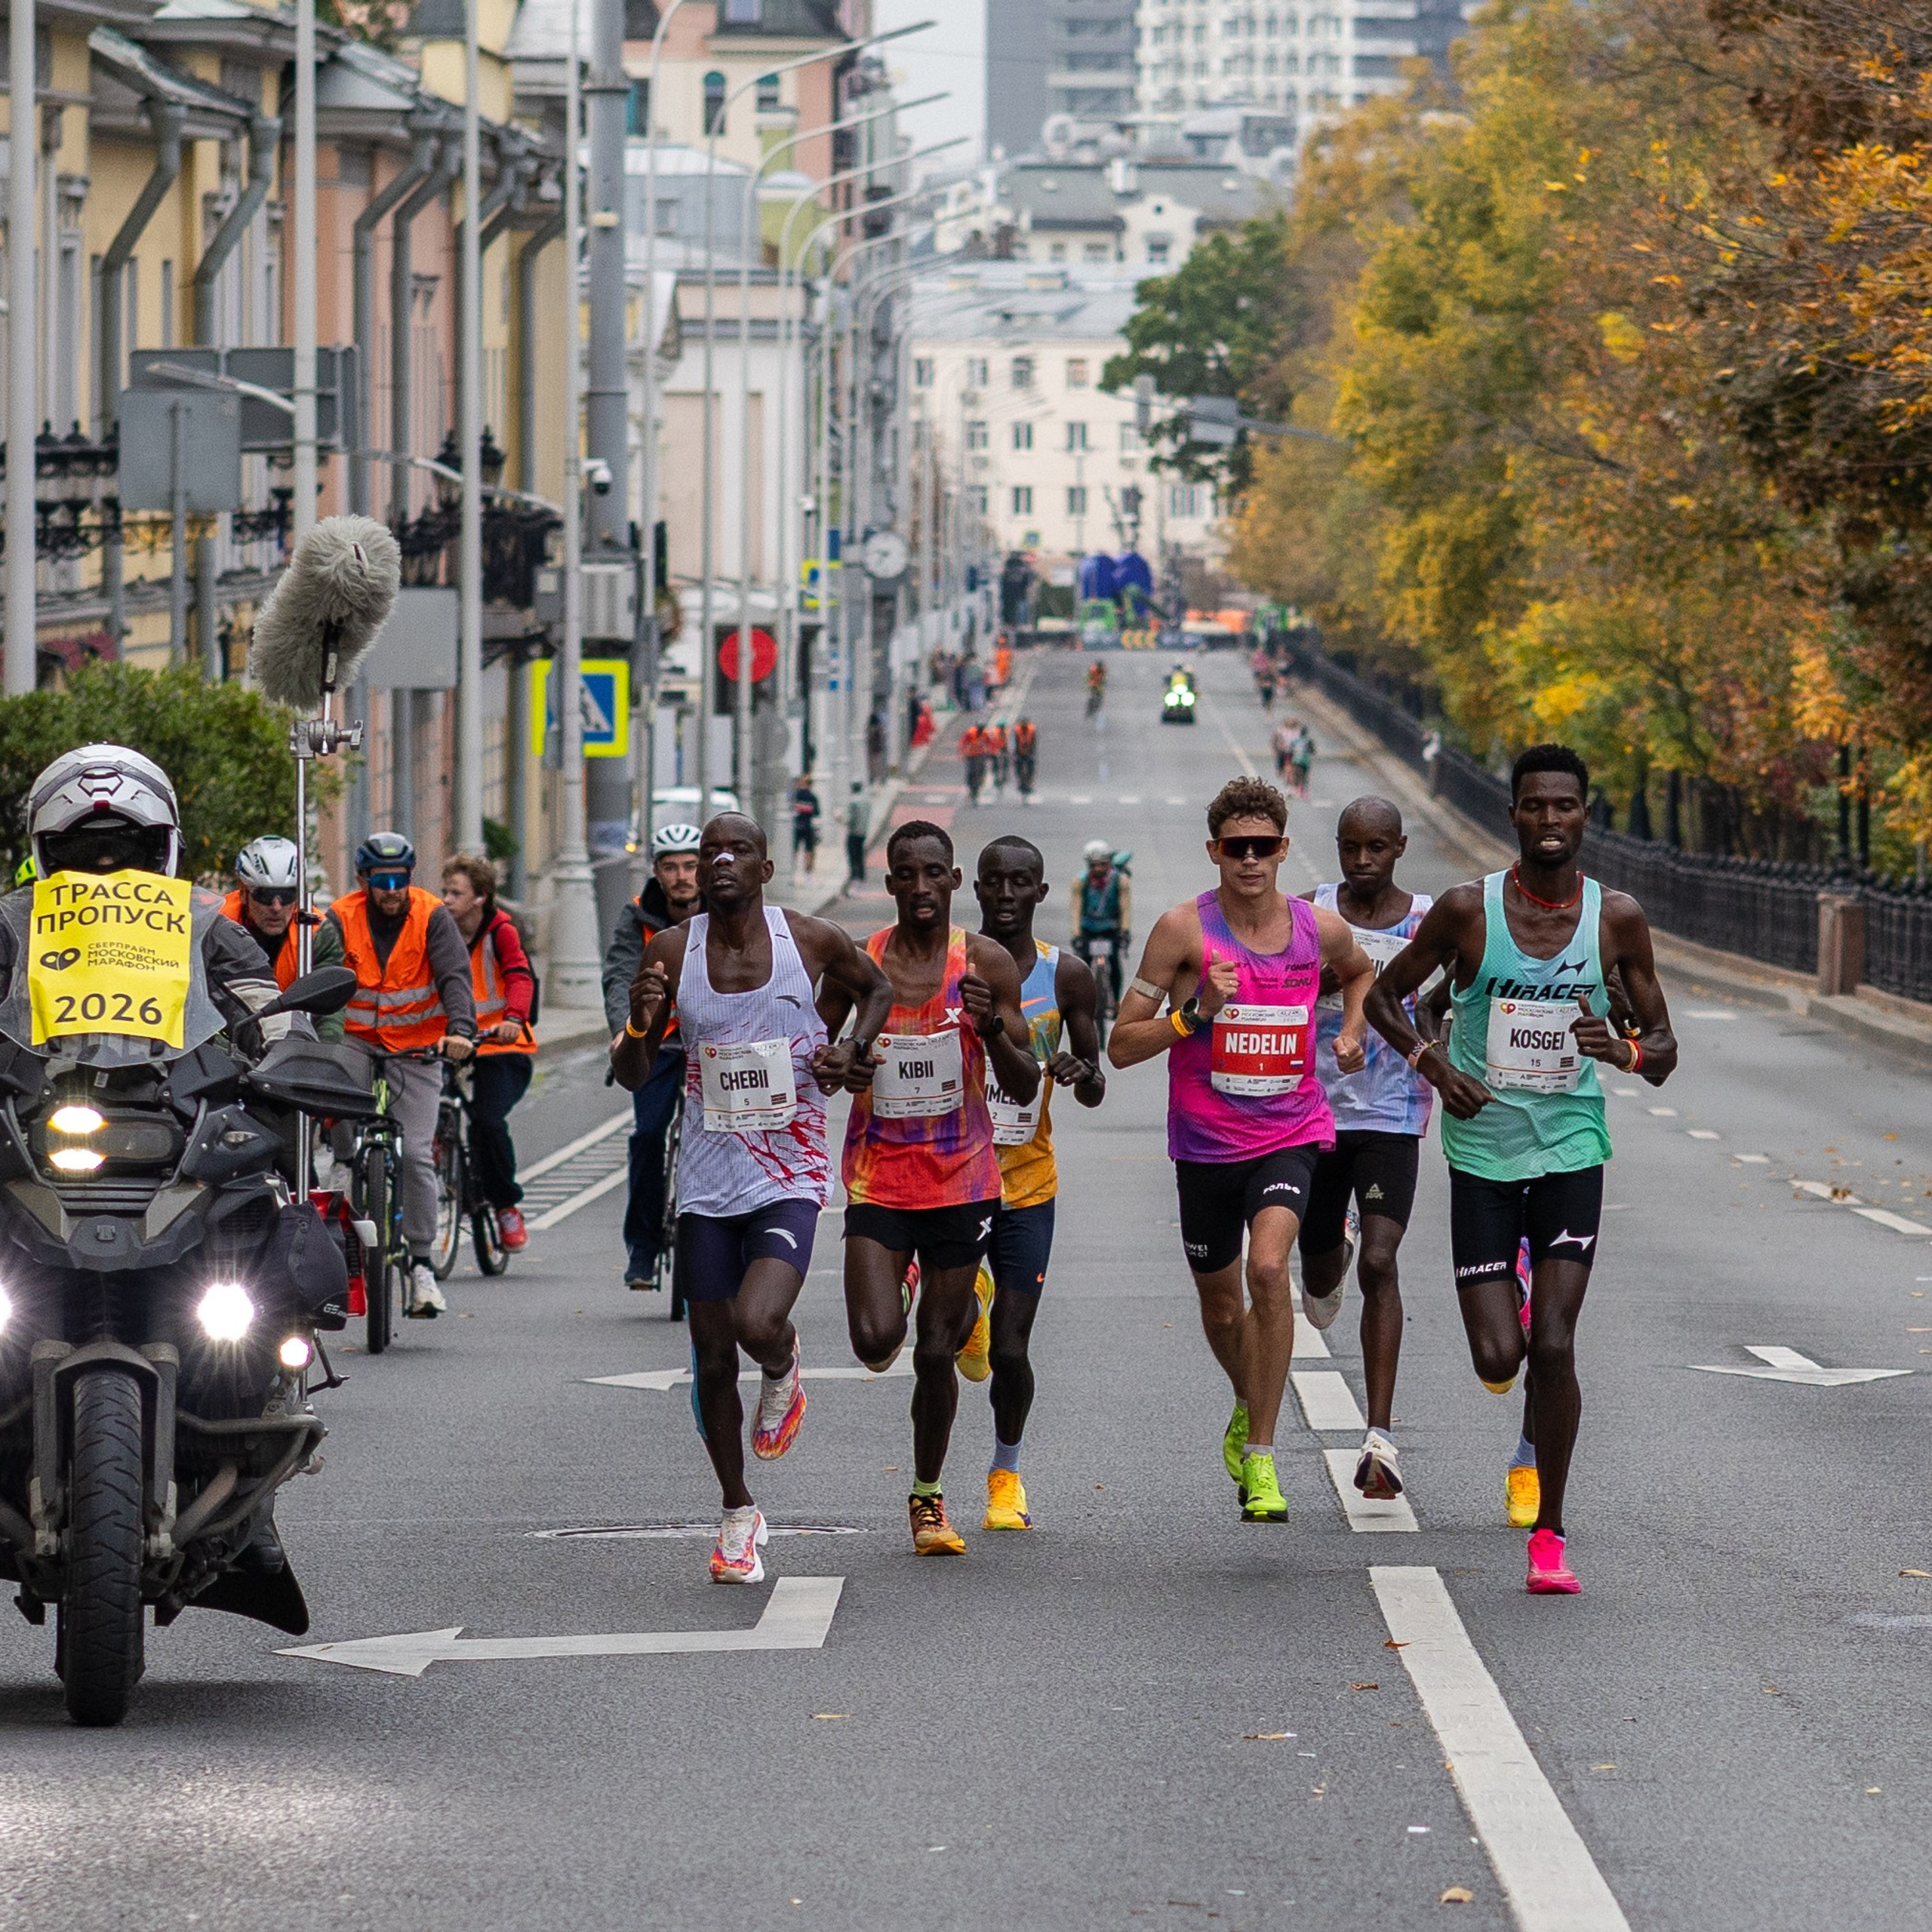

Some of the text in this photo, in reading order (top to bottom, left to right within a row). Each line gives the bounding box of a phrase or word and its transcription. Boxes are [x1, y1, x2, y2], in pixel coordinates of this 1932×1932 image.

[50, 881, 175, 907] ТРАССА
[37, 904, 186, 936] ПРОПУСК
[88, 941, 155, 955] СБЕРПРАЙМ
[88, 949, 180, 968] МОСКОВСКИЙ
[88, 957, 155, 971] МАРАФОН
[1484, 977, 1598, 1001] HIRACER
[54, 992, 164, 1026] 2026
[1225, 1032, 1297, 1055] NEDELIN
[1509, 1027, 1566, 1051] KOSGEI
[898, 1060, 934, 1080] KIBII
[1259, 1062, 1264, 1071] 1
[1531, 1058, 1542, 1067] 15
[719, 1069, 770, 1091] CHEBII
[743, 1097, 750, 1106] 5
